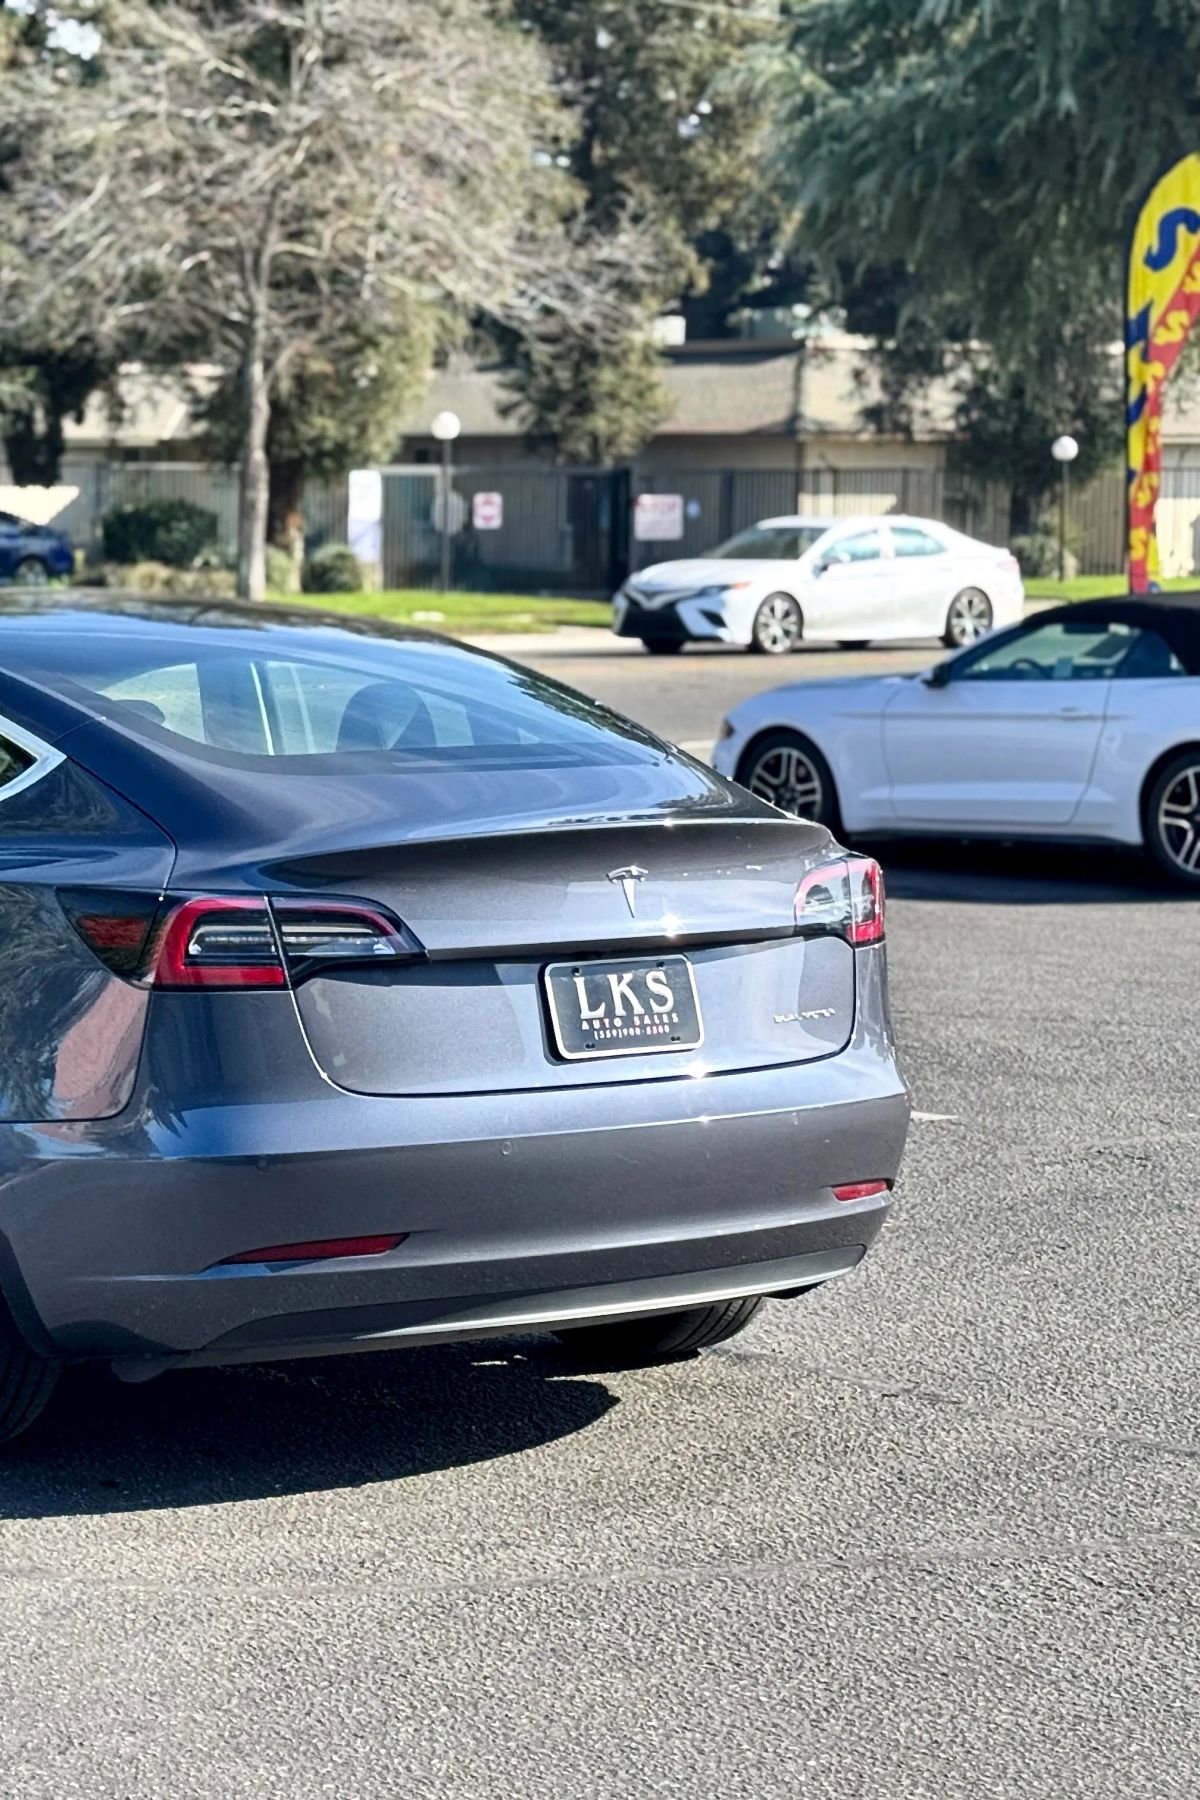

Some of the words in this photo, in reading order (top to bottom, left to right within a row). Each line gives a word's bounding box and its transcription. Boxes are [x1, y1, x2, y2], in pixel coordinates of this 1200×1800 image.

[573, 970, 674, 1019] LKS
[581, 1018, 622, 1030] AUTO
[633, 1012, 679, 1025] SALES
